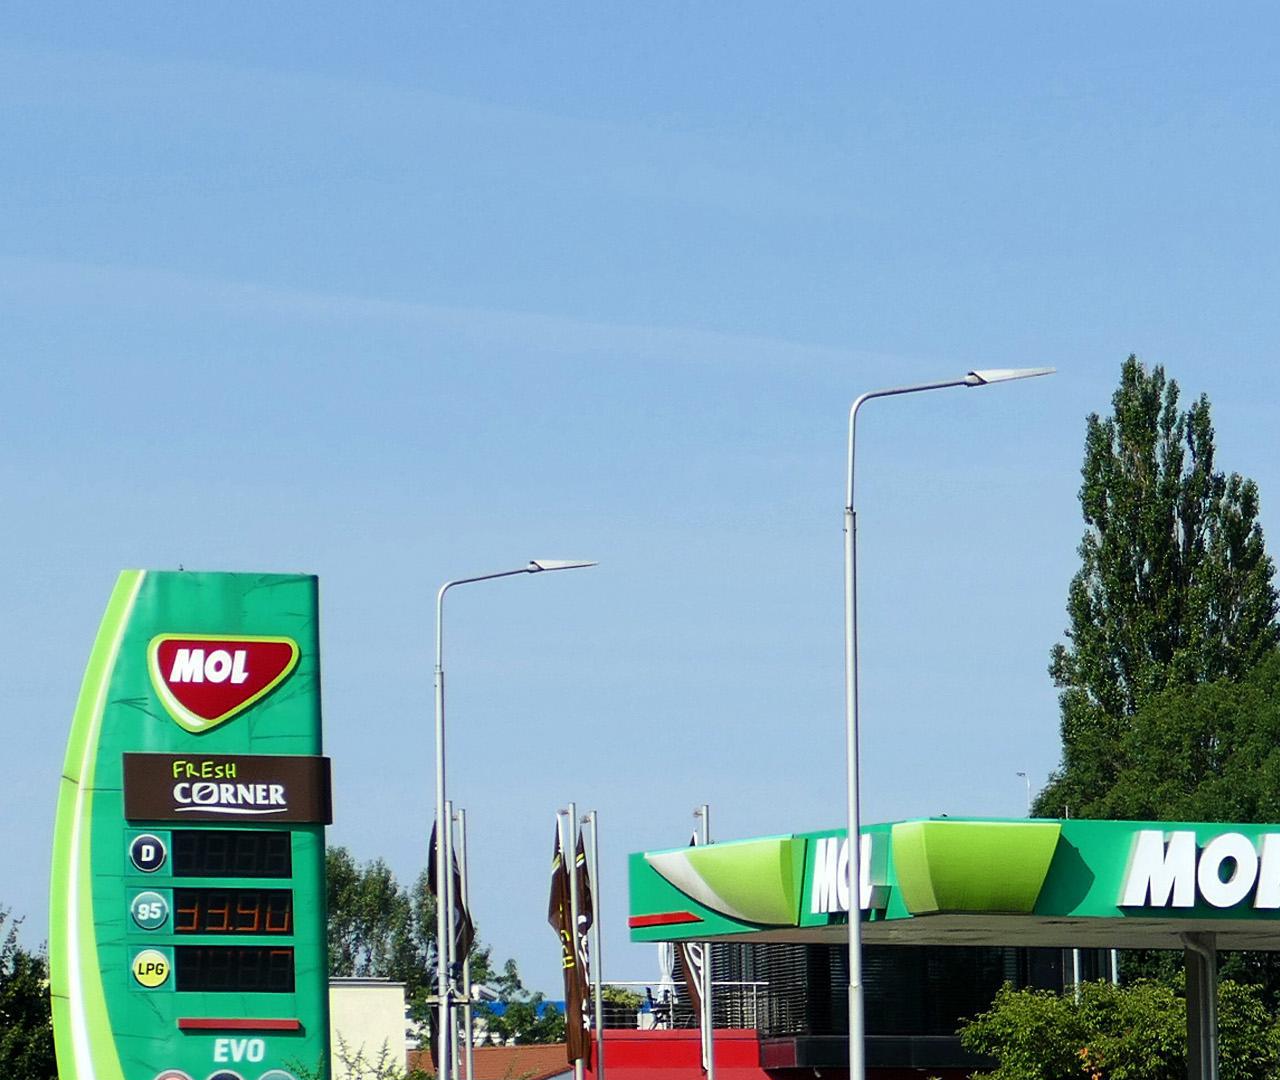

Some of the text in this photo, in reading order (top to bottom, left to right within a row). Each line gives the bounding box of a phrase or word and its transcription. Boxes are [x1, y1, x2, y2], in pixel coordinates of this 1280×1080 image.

[169, 648, 249, 684] MOL
[172, 760, 237, 779] FRESH
[173, 782, 287, 806] CORNER
[141, 845, 155, 862] D
[138, 902, 162, 921] 95
[138, 963, 165, 976] LPG
[213, 1038, 265, 1063] EVO
